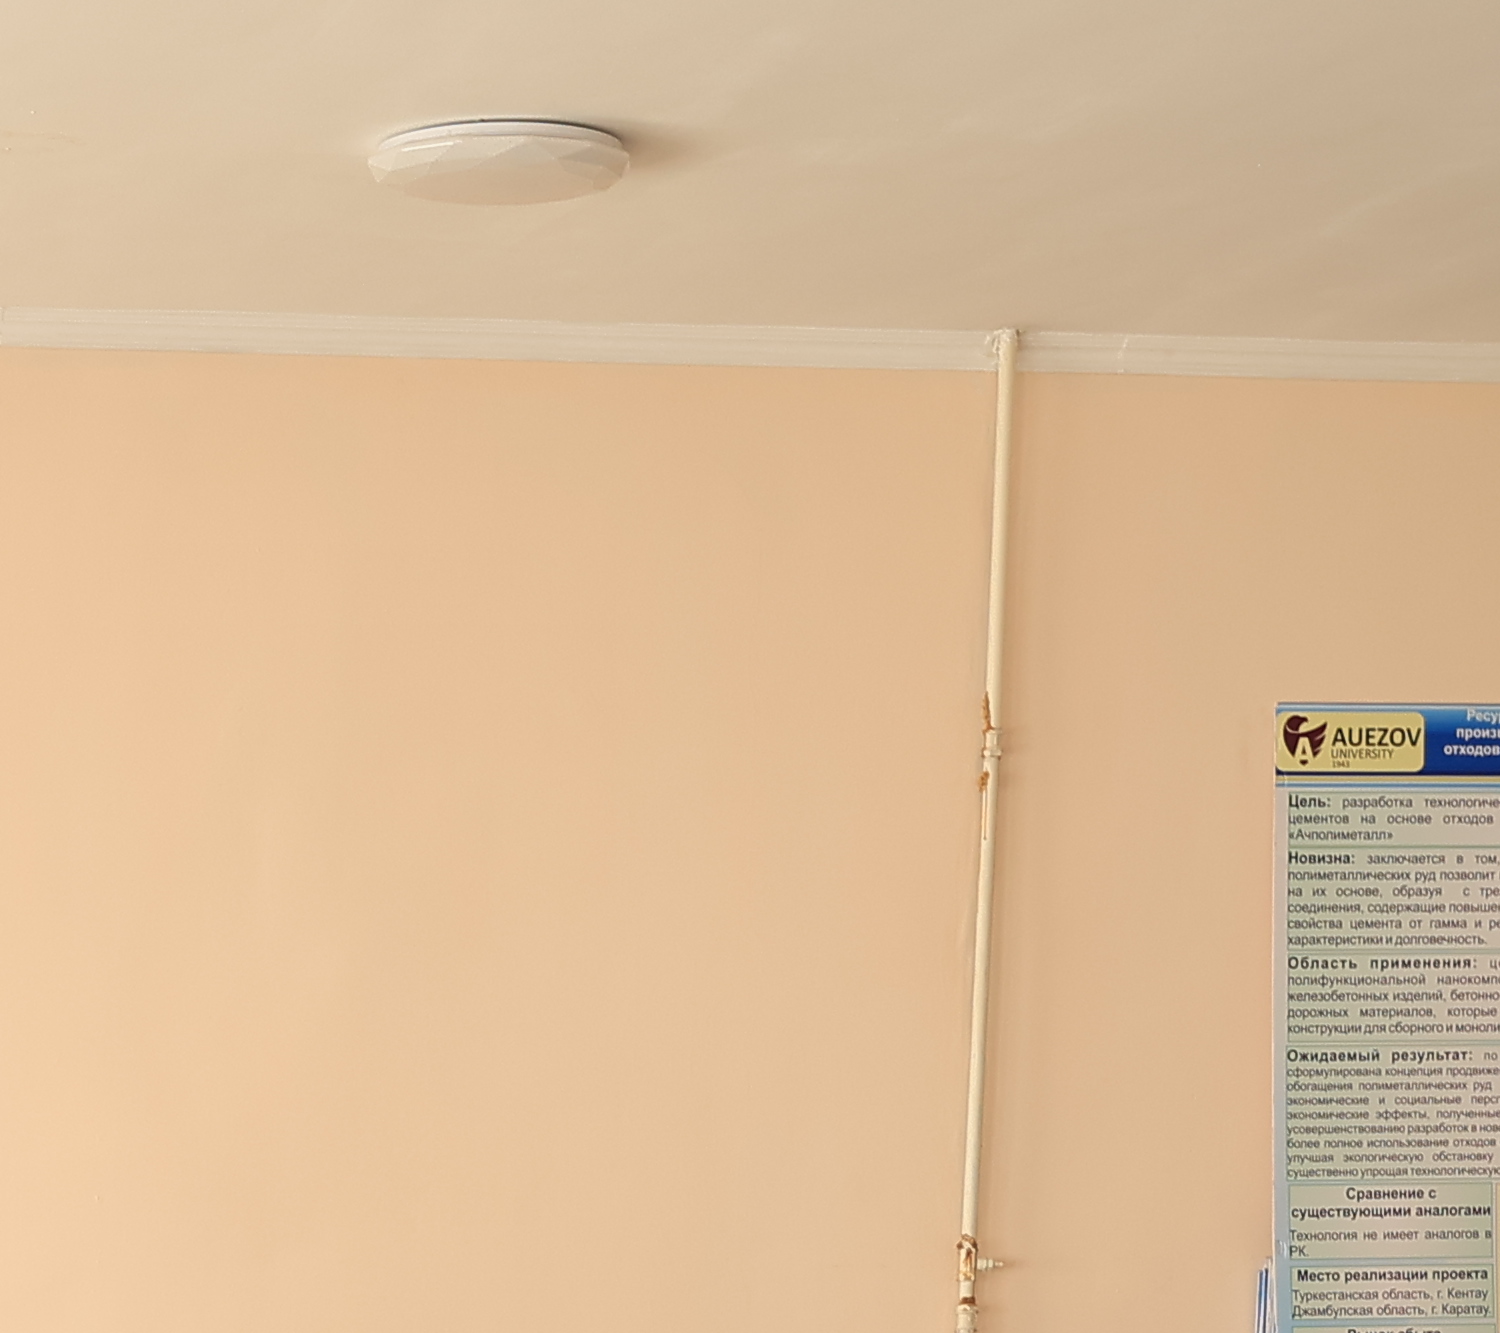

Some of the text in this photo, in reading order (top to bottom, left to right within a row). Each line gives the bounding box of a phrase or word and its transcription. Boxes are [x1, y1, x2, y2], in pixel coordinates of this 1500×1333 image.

[1330, 726, 1422, 748] AUEZOV
[1330, 748, 1394, 760] UNIVERSITY
[1443, 745, 1500, 757] отходов
[1332, 760, 1350, 768] 1943
[1288, 794, 1330, 810] Цель:
[1341, 796, 1413, 810] разработка
[1287, 814, 1349, 826] цементов
[1360, 814, 1376, 824] на
[1386, 814, 1432, 824] основе
[1442, 815, 1494, 826] отходов
[1346, 1187, 1438, 1202] Сравнение с
[1290, 1206, 1491, 1221] существующими аналогами
[1296, 1269, 1488, 1284] Место реализации проекта
[1292, 1288, 1488, 1304] Туркестанская область, г. Кентау
